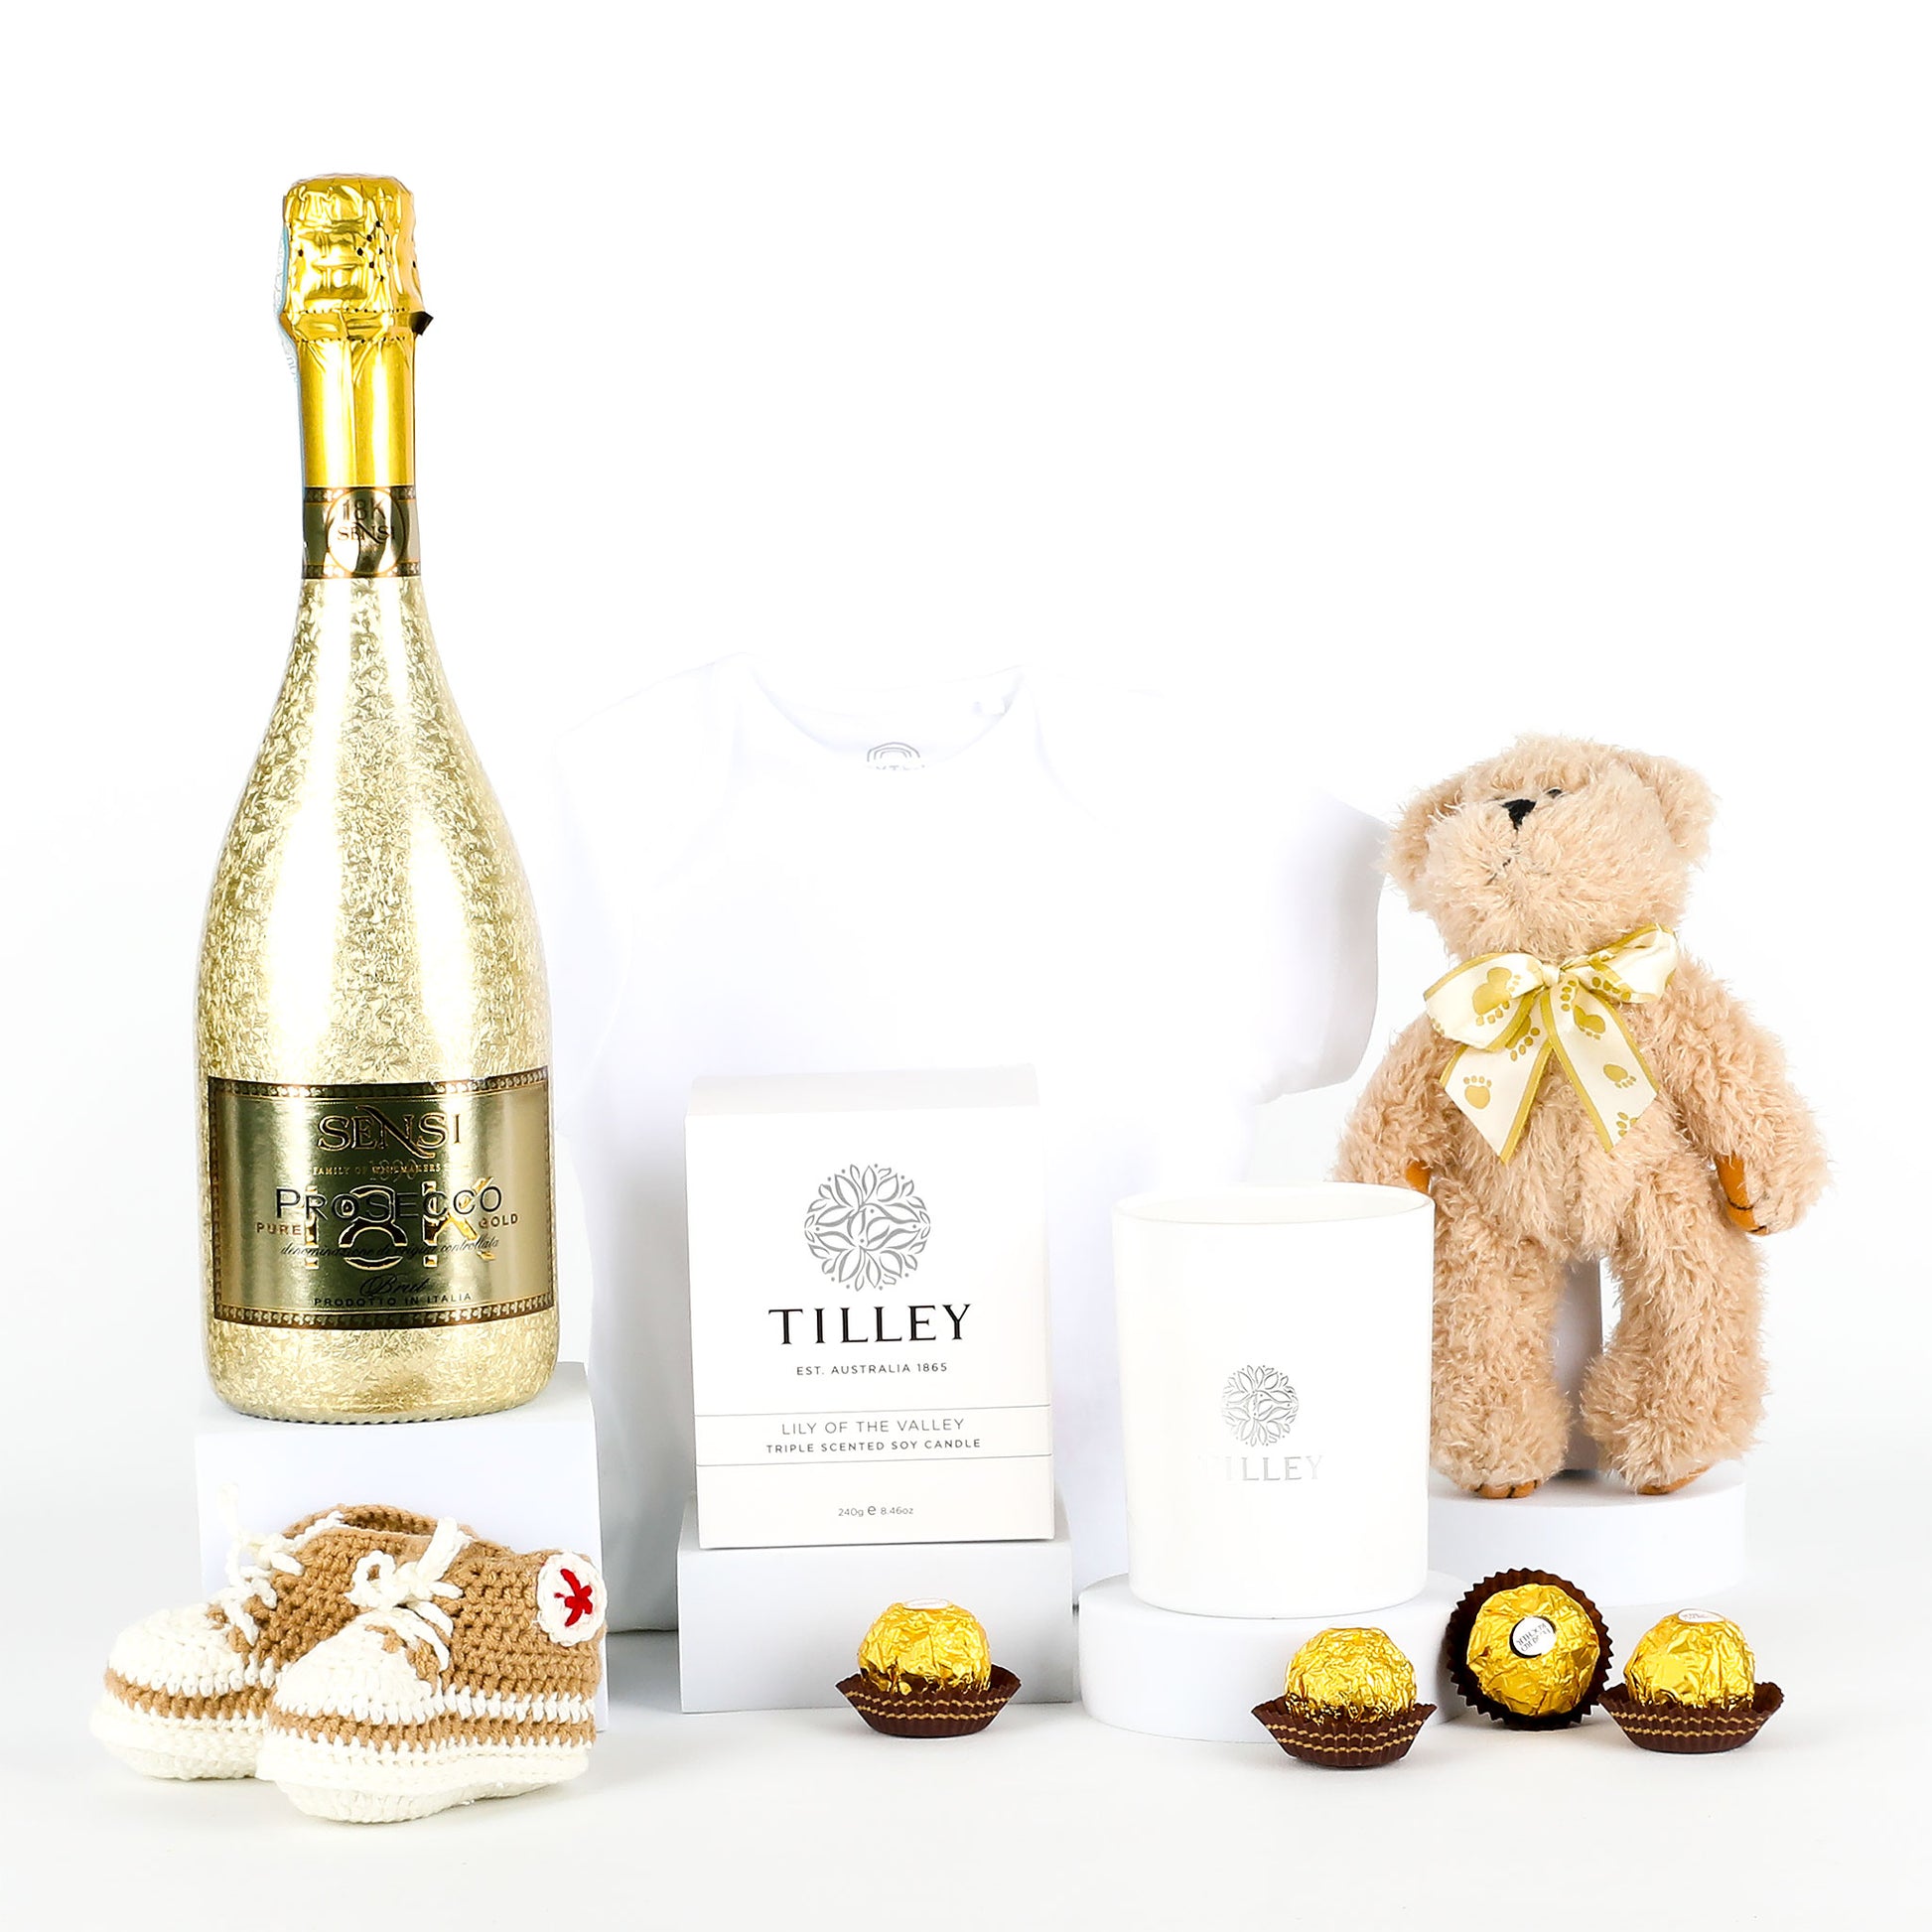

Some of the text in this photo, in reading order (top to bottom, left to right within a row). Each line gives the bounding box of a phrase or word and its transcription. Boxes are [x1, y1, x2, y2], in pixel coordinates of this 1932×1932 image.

[343, 497, 386, 521] 18K
[338, 521, 395, 545] SENSI
[317, 1104, 462, 1160] SENSI
[275, 1185, 502, 1221] PROSECCO
[256, 1221, 302, 1236] PURE
[478, 1212, 518, 1229] GOLD
[358, 1273, 431, 1298] Brut
[313, 1293, 472, 1308] PRODOTTO IN ITALIA
[767, 1304, 973, 1345] TILLEY
[796, 1362, 948, 1376] EST. AUSTRALIA 1865
[781, 1418, 965, 1437] LILY OF THE VALLEY
[765, 1439, 981, 1454] TRIPLE SCENTED SOY CANDLE
[1195, 1453, 1324, 1481] ILLEY
[838, 1507, 864, 1518] 240g
